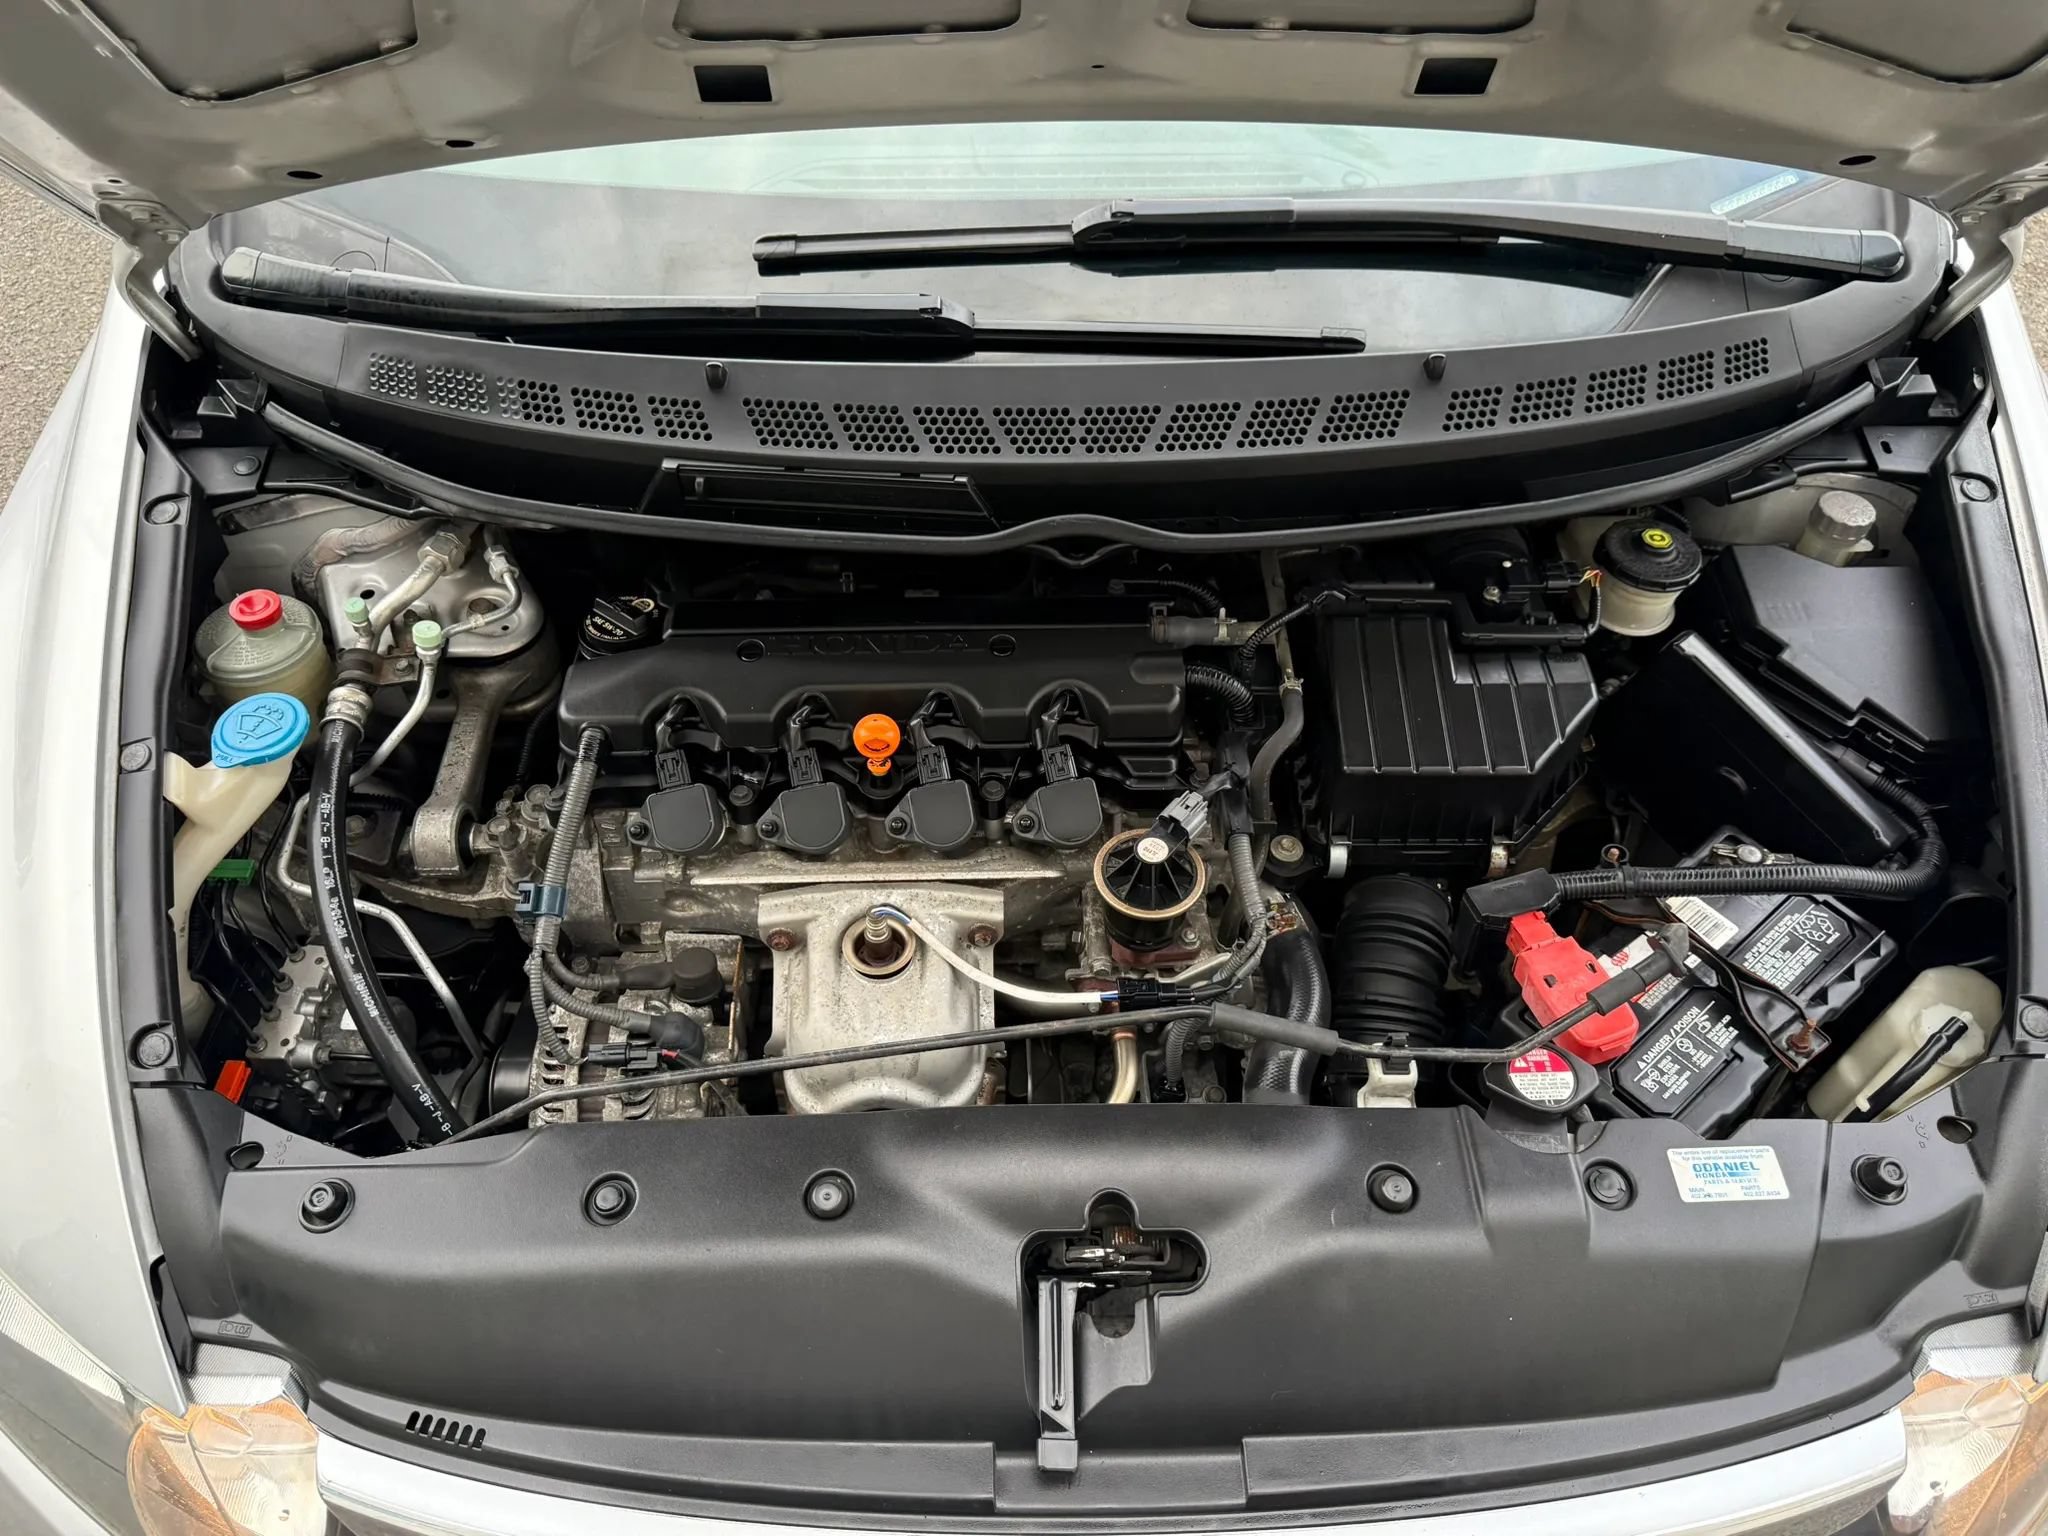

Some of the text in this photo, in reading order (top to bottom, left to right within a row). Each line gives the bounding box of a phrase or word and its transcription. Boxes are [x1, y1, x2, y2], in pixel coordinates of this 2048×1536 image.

[215, 753, 233, 764] PULL
[353, 972, 379, 1018] NICHIRIN
[1642, 1034, 1673, 1063] DANGER
[1674, 1006, 1701, 1033] POISON
[1719, 1148, 1754, 1156] replacement
